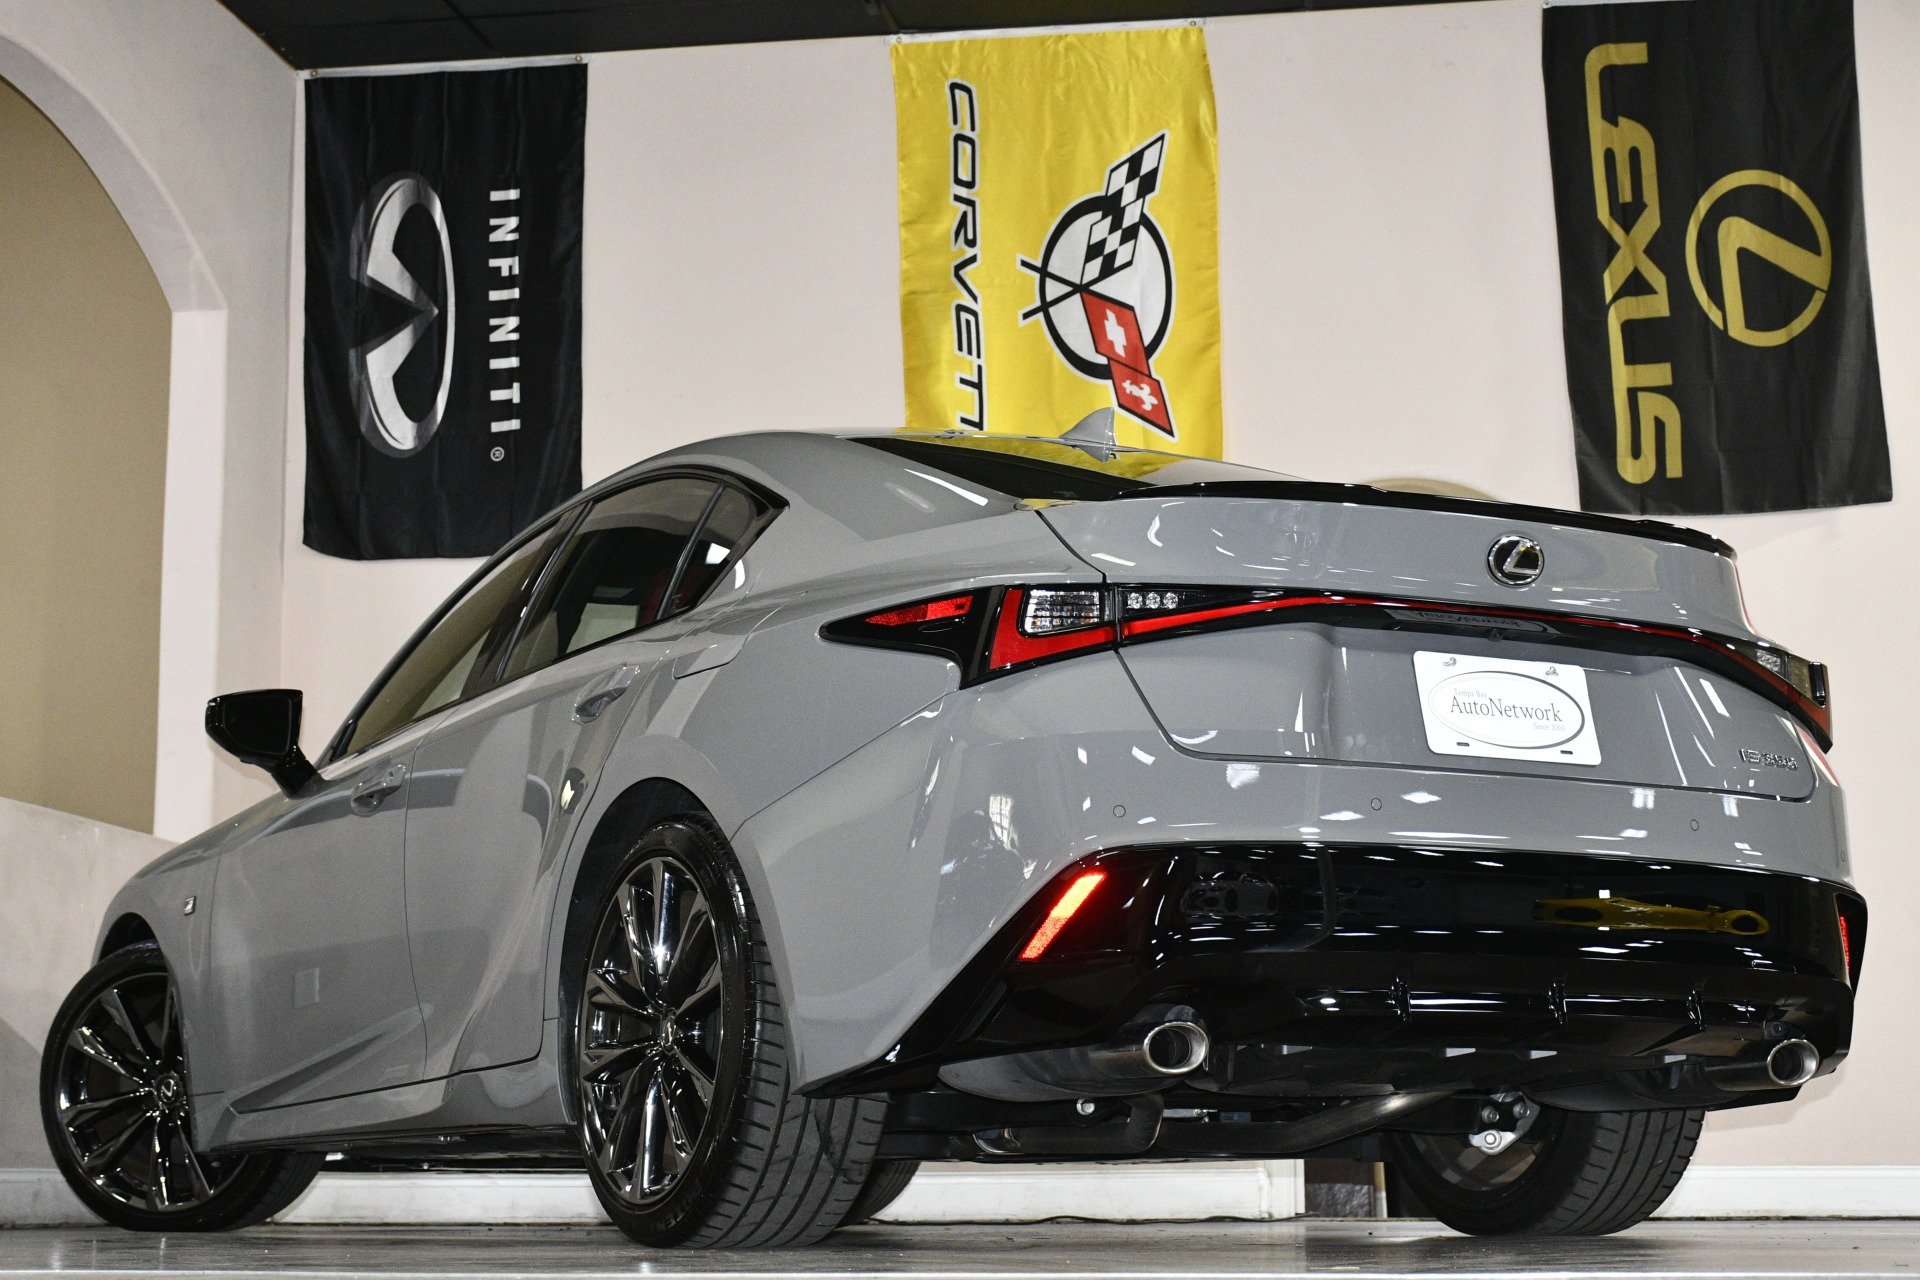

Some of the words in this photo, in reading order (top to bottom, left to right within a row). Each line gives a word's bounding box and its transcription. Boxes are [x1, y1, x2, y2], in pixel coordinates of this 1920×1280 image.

[489, 188, 521, 433] INFINITI
[1584, 41, 1683, 485] LEXUS
[1450, 695, 1563, 722] AutoNetwork
[1739, 748, 1761, 765] IS
